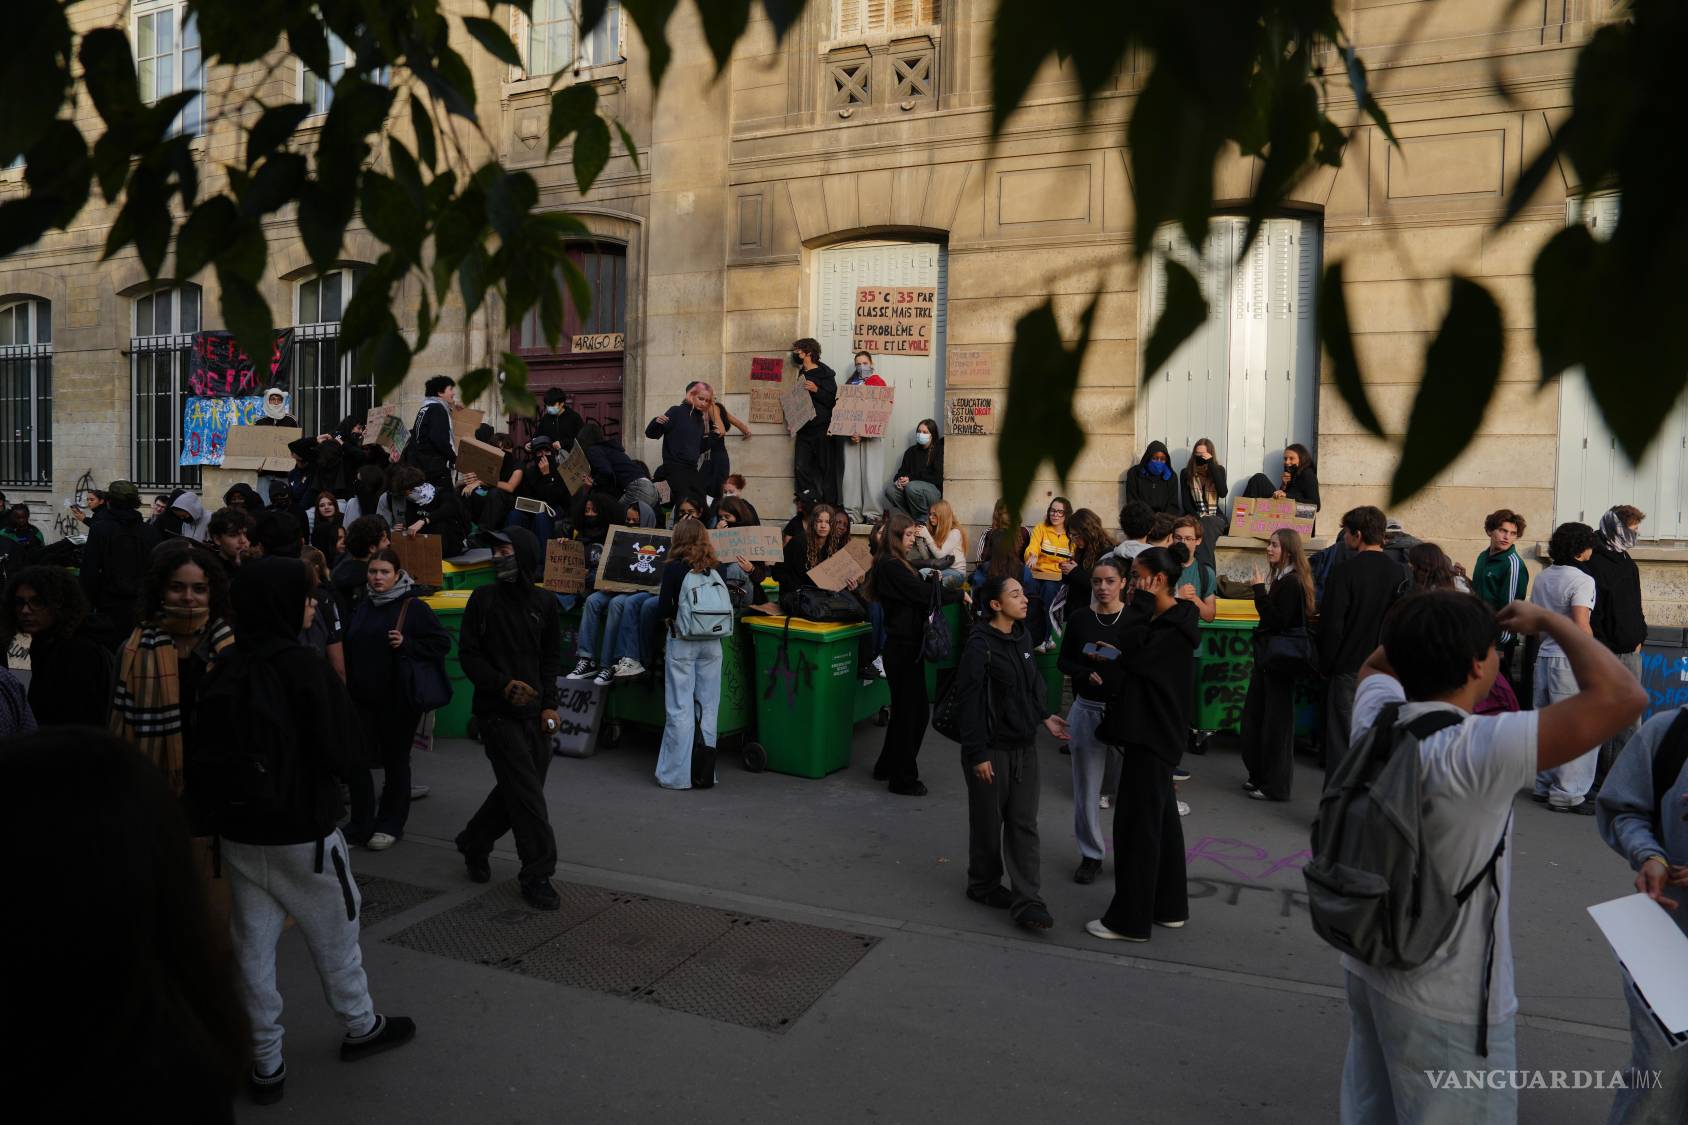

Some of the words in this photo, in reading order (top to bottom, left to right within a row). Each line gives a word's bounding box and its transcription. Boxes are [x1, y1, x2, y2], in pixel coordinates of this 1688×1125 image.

[898, 292, 914, 303] 35
[917, 292, 934, 303] PAR
[857, 306, 889, 318] CLASSE
[855, 324, 864, 335] LE
[866, 321, 913, 337] PROBLÈME
[918, 325, 926, 337] C
[854, 340, 863, 350] LE
[864, 340, 879, 350] TEL
[884, 340, 895, 351] ET
[897, 340, 906, 350] LE
[908, 340, 928, 351] VOILE
[974, 407, 992, 416] DROIT
